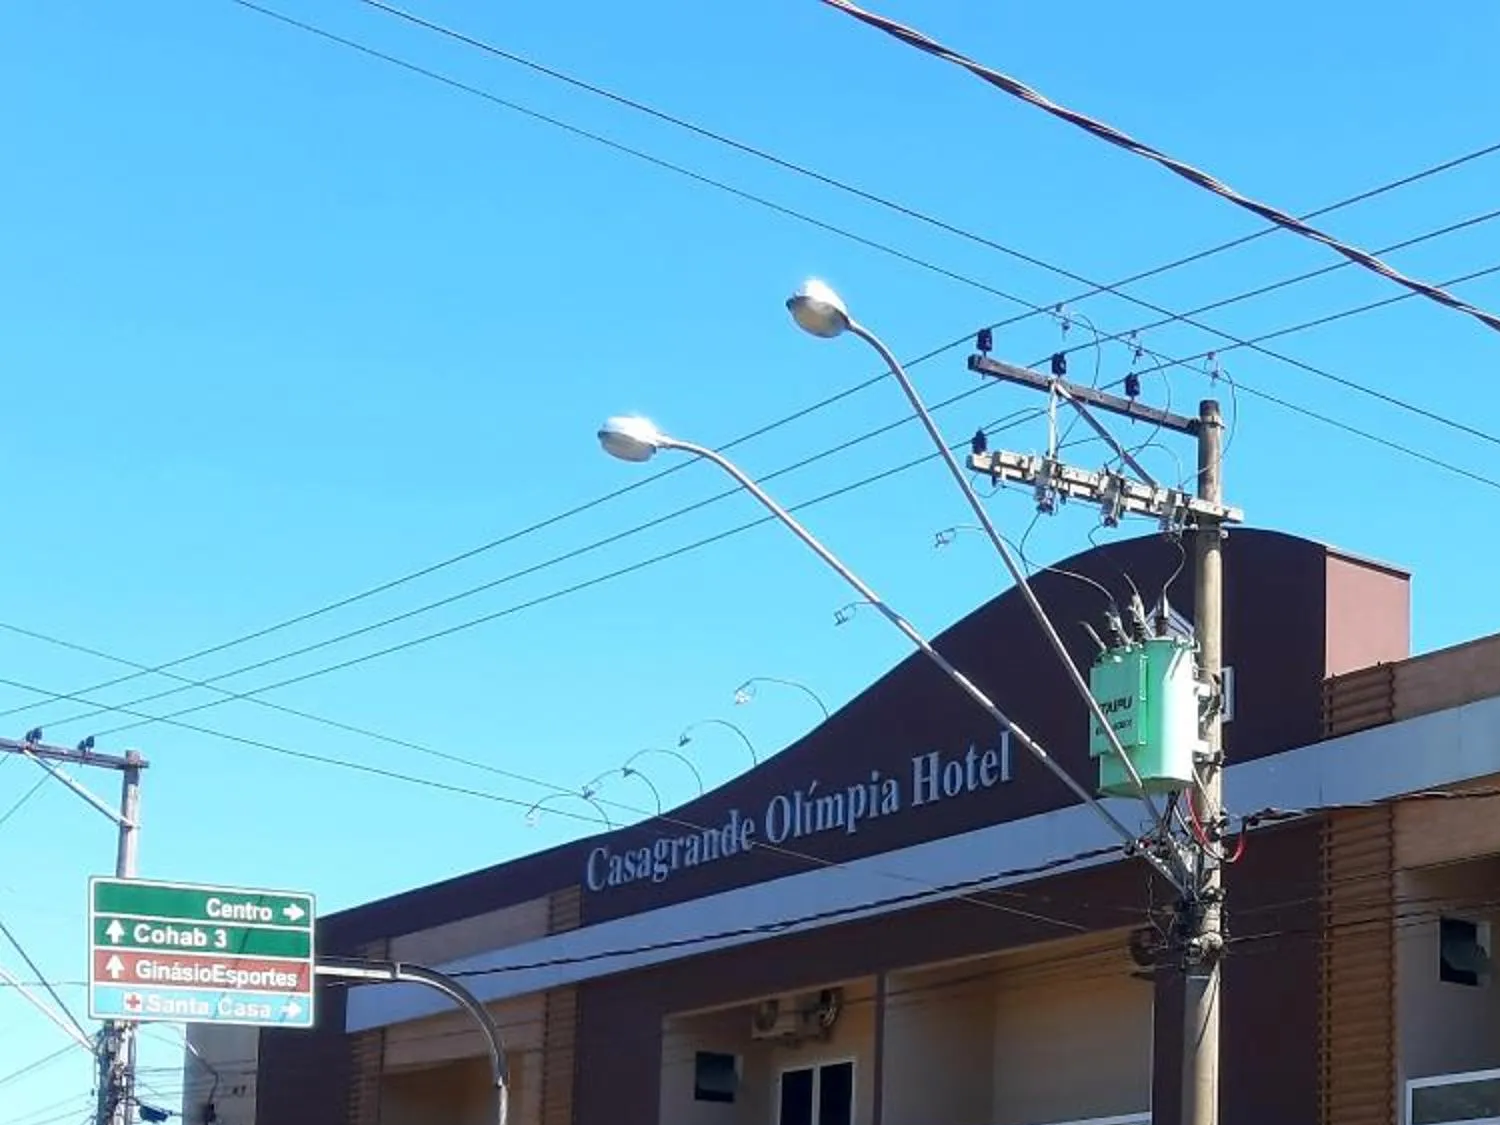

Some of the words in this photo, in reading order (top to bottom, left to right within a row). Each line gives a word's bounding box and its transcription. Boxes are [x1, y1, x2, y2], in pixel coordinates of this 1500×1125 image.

[1092, 695, 1133, 715] TAIPU
[586, 810, 756, 891] Casagrande
[765, 780, 900, 844] Olímpia
[911, 731, 1014, 807] Hotel
[205, 897, 273, 921] Centro
[133, 923, 208, 947] Cohab
[214, 929, 228, 948] 3
[135, 960, 298, 988] GinásioEsportes
[146, 994, 209, 1015] Santa
[217, 998, 272, 1018] Casa
